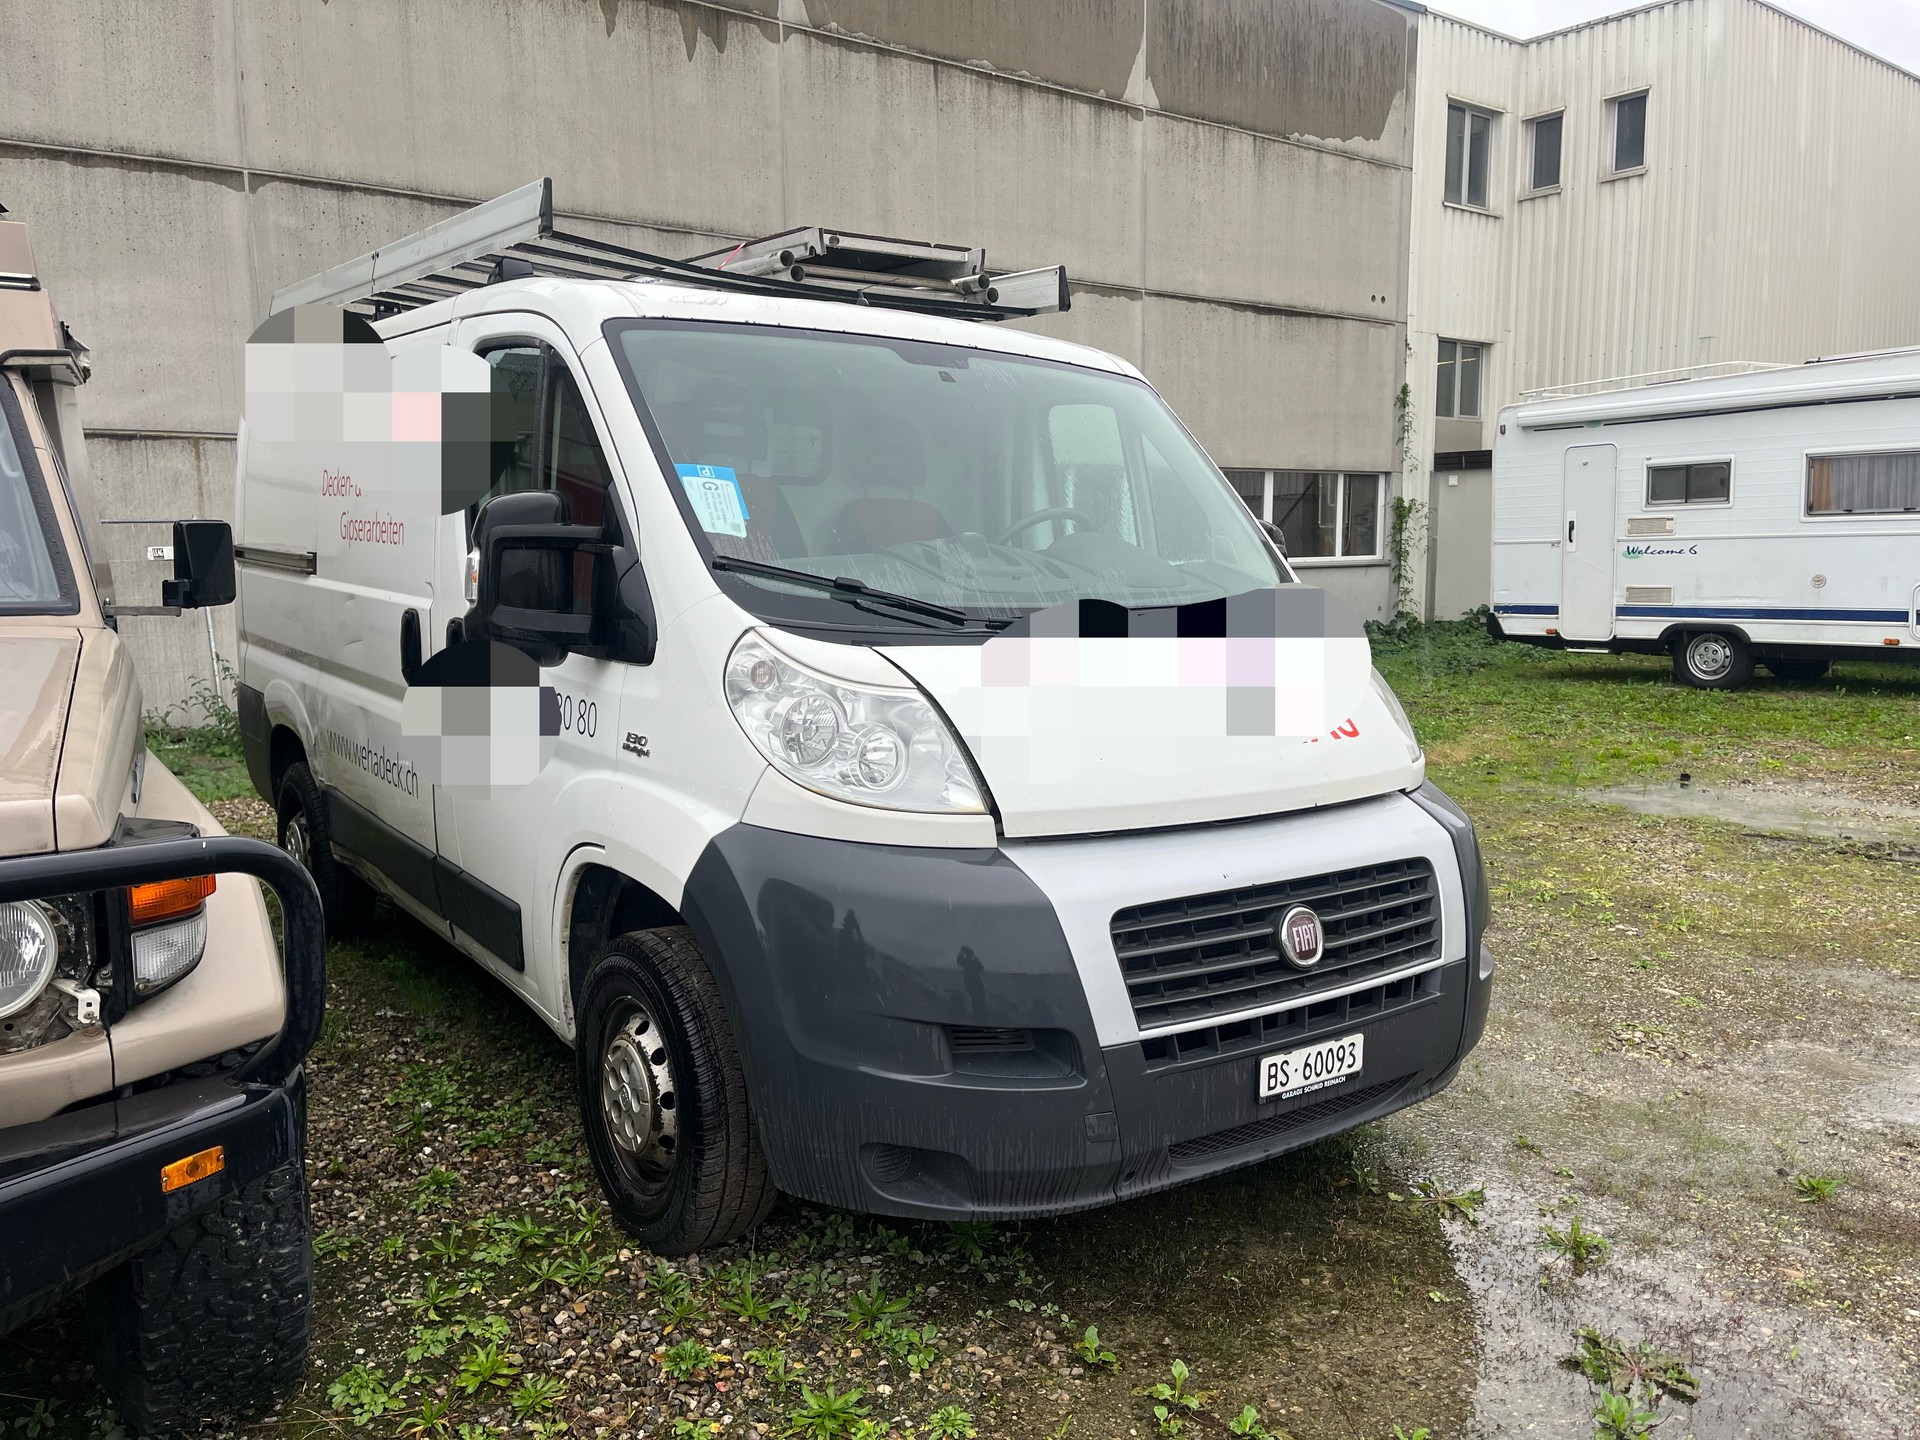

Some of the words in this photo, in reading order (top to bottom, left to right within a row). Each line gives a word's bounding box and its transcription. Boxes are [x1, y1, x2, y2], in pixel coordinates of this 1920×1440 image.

[322, 467, 354, 497] Decken-
[702, 481, 719, 491] G
[340, 510, 405, 548] Gipserarbeiten
[1626, 545, 1686, 555] Welcome
[1688, 544, 1698, 555] 6
[577, 698, 597, 738] 80
[326, 728, 419, 800] www.wehadeck.ch
[1292, 923, 1316, 953] FIAT
[1281, 1089, 1303, 1100] GARAGE
[1324, 1075, 1346, 1088] REINACH
